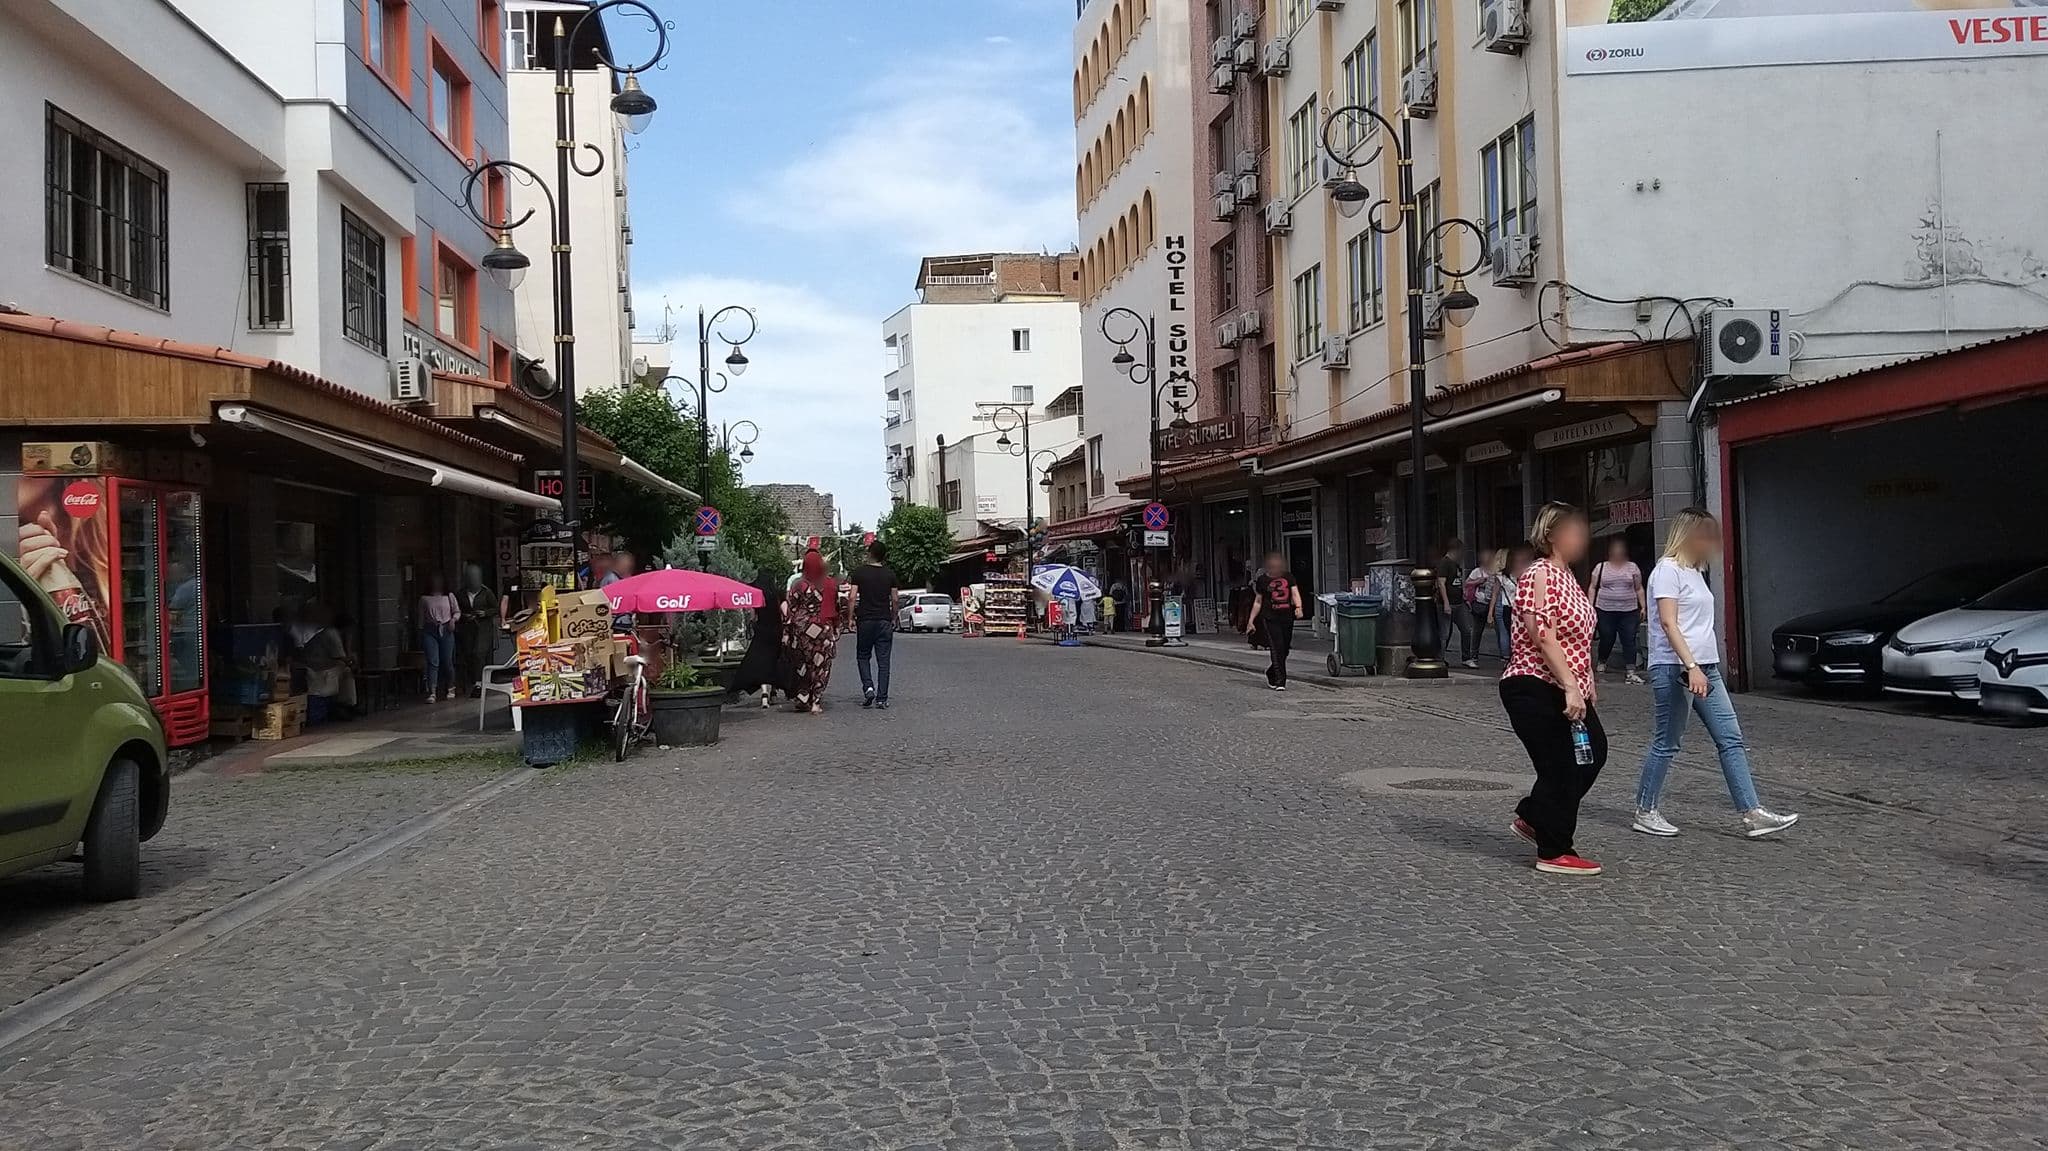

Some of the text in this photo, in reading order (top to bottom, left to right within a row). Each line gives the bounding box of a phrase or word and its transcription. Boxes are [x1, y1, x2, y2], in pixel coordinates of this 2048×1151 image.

[1949, 16, 2048, 44] VESTE
[1608, 47, 1645, 58] ZORLU
[1165, 235, 1187, 312] HOTEL
[1770, 310, 1780, 356] BEKO
[540, 479, 591, 495] HOL
[1269, 577, 1290, 601] 3
[611, 596, 623, 610] lf
[656, 595, 692, 609] Golf
[731, 591, 753, 606] Golf
